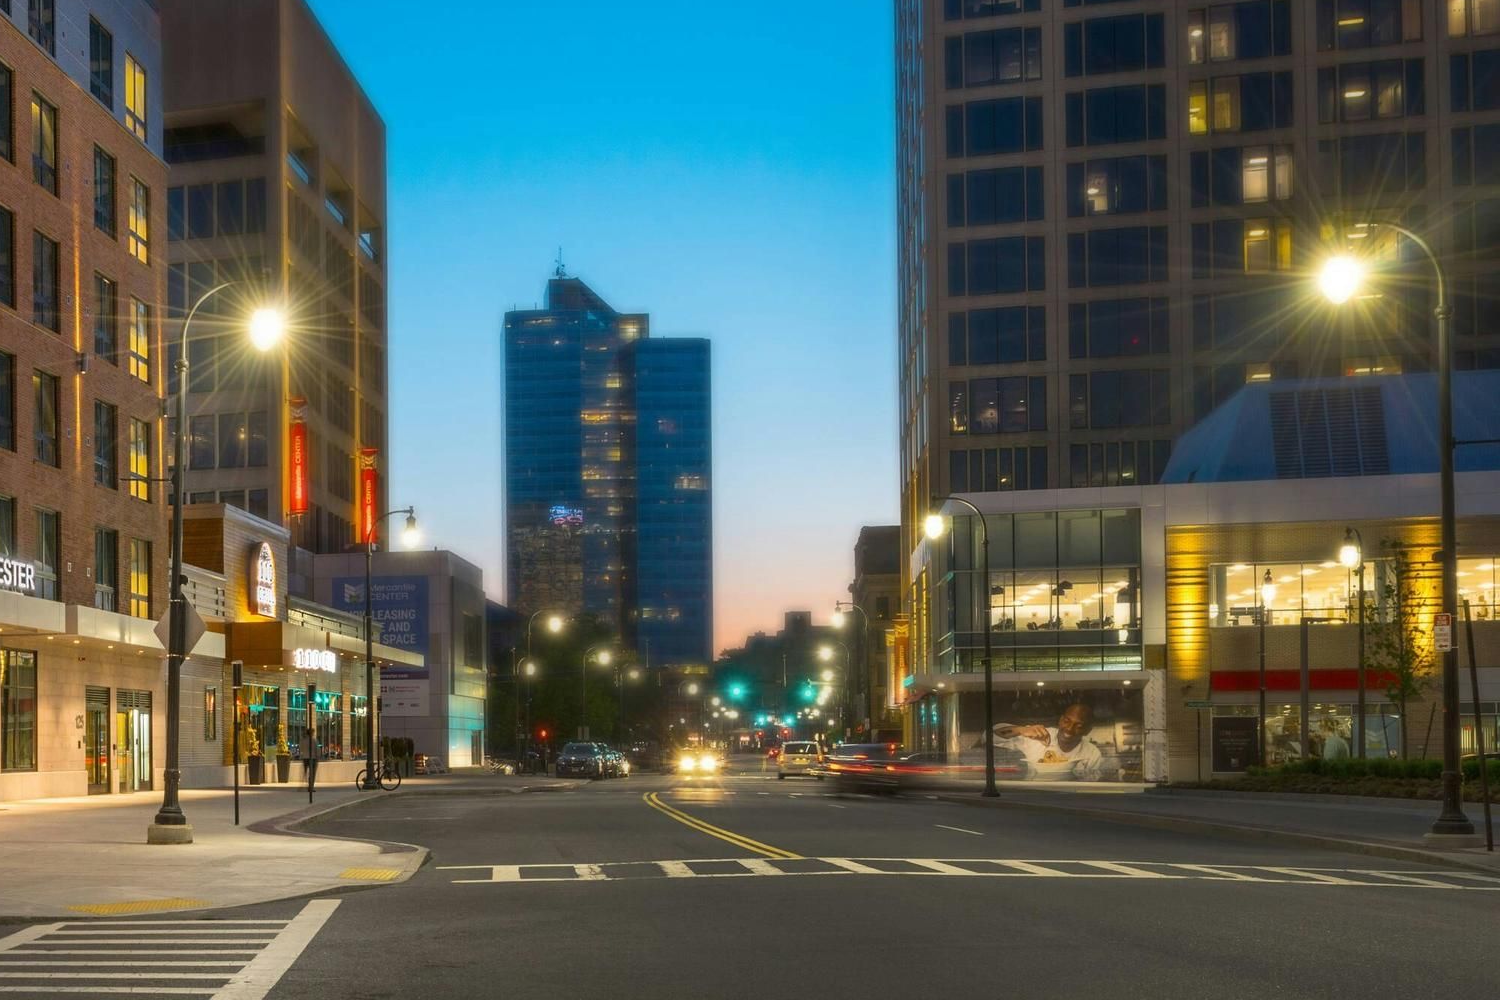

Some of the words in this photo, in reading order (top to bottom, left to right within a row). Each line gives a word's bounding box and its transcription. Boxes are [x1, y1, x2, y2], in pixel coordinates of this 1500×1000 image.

[370, 592, 409, 601] CENTER
[372, 609, 416, 620] LEASING
[388, 622, 411, 633] AND
[382, 633, 417, 645] SPACE
